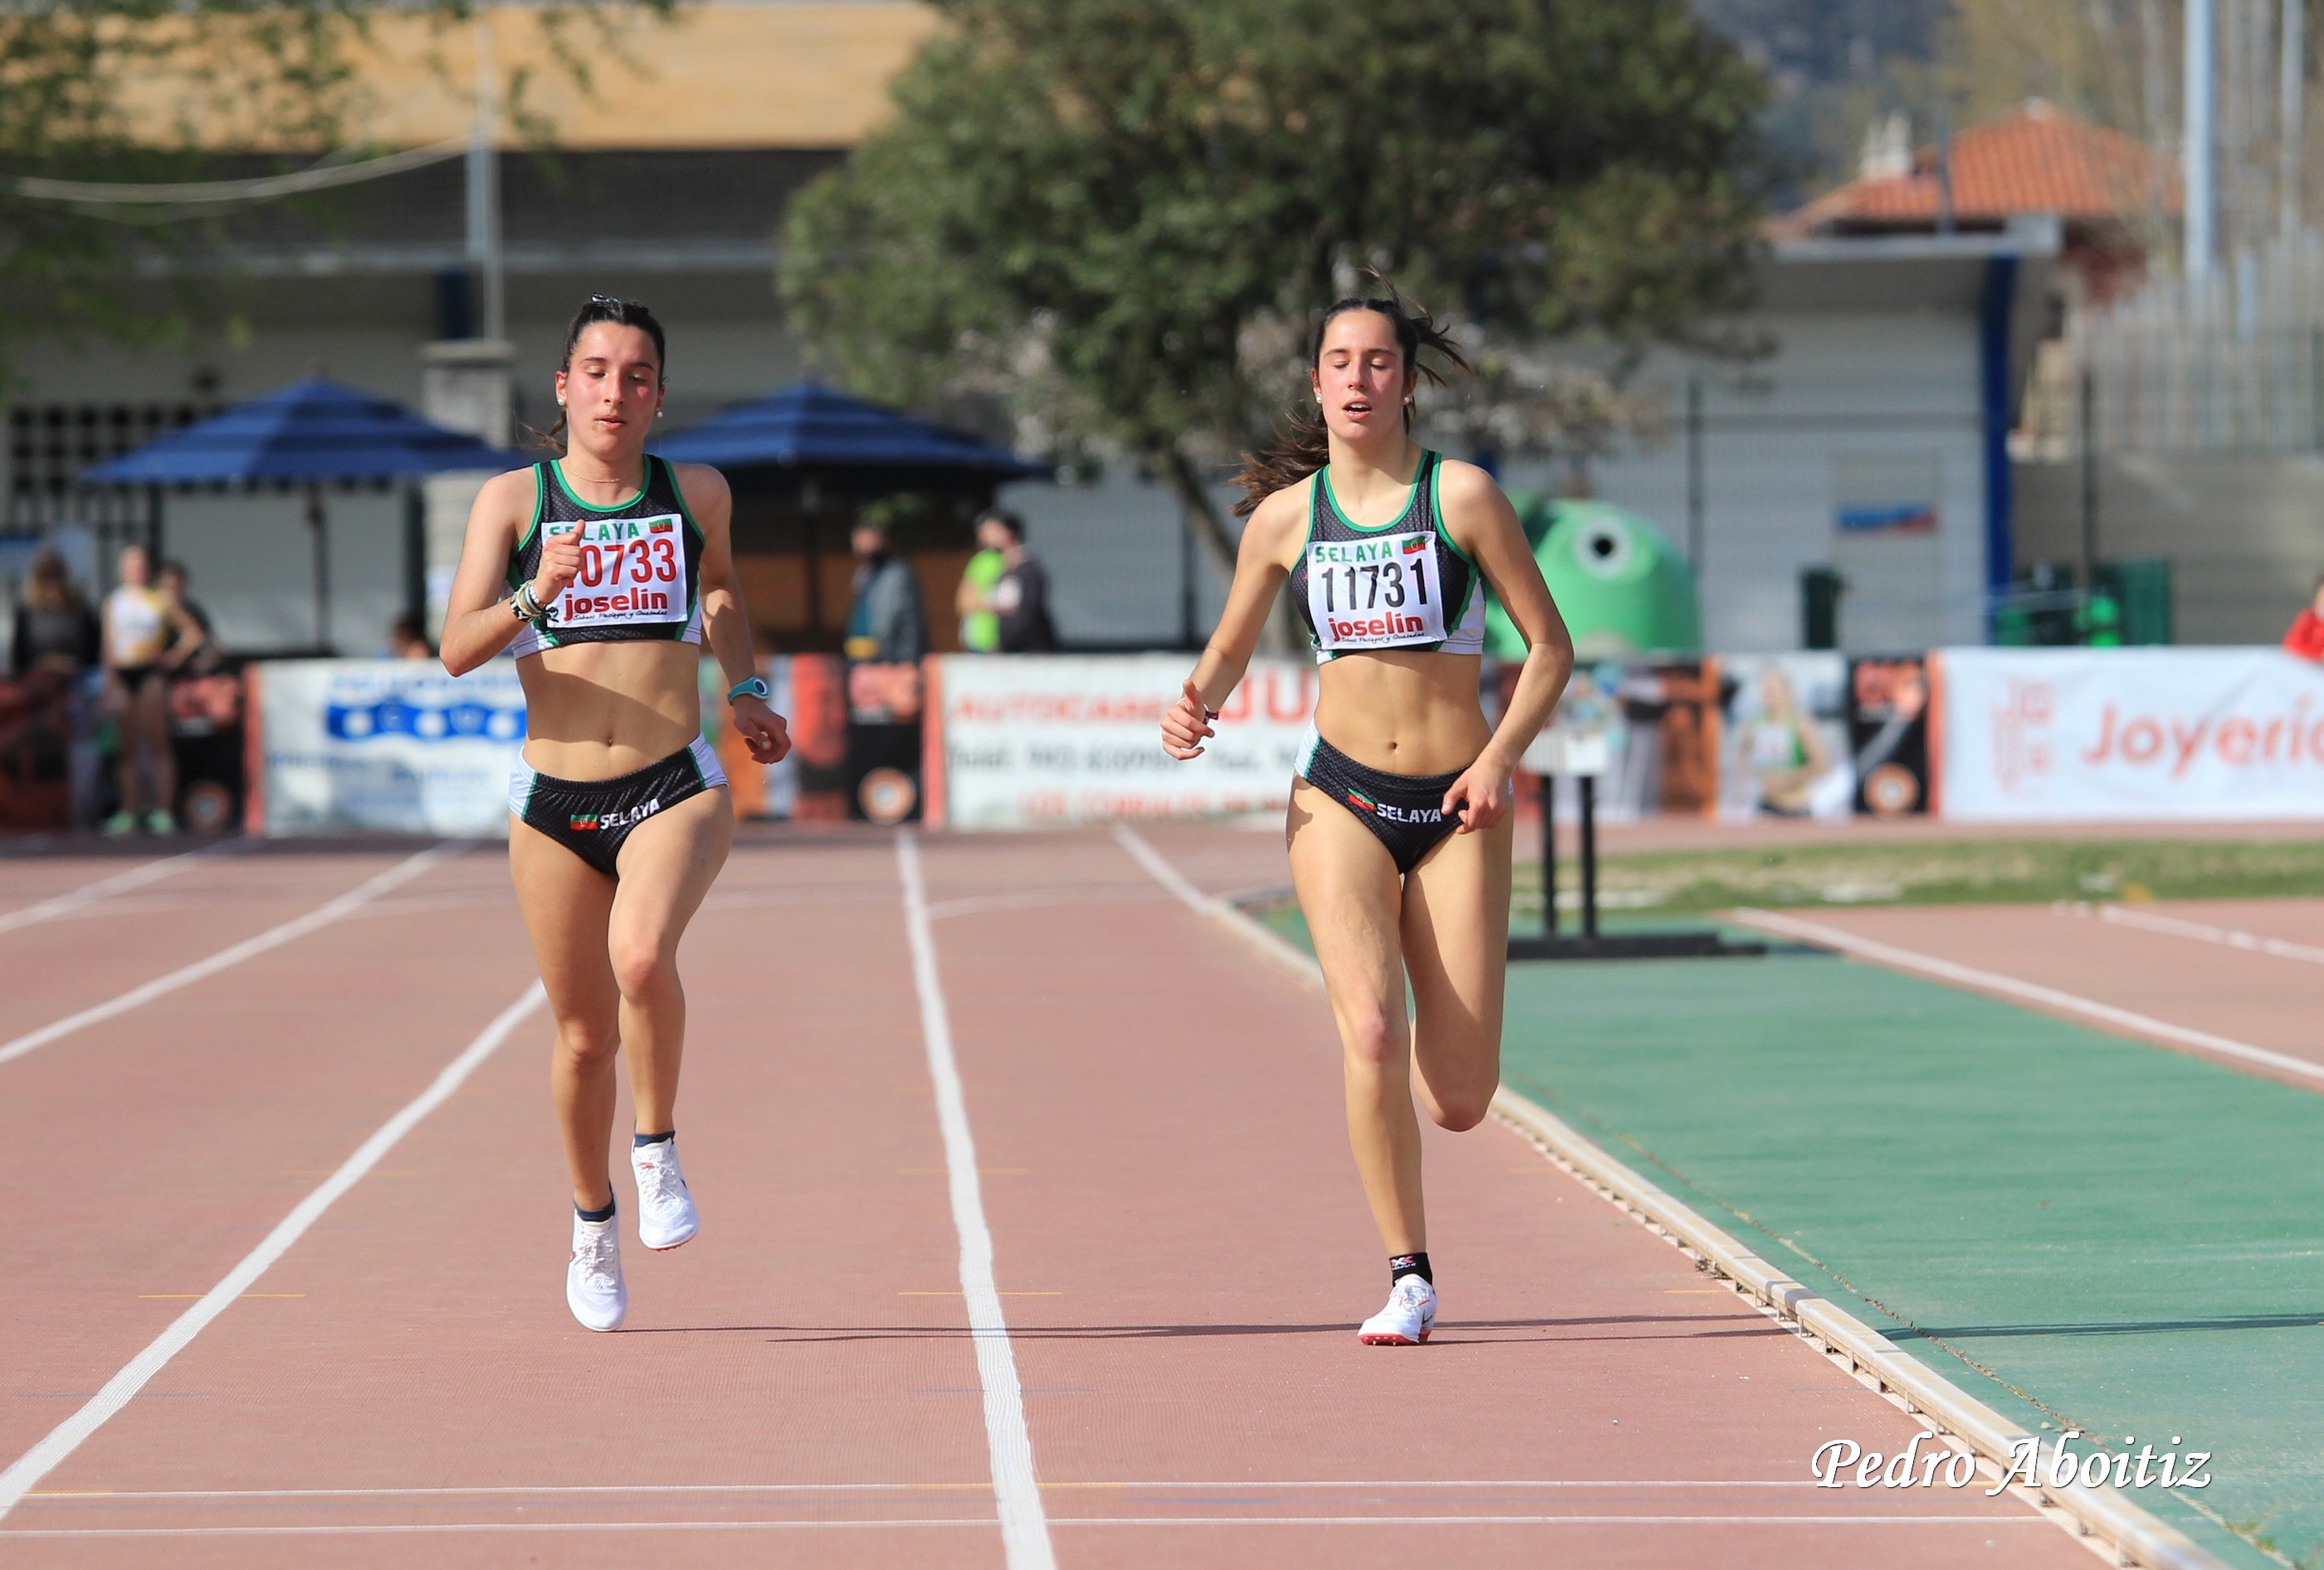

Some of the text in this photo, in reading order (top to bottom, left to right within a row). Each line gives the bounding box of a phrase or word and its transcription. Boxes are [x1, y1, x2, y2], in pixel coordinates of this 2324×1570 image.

[566, 539, 677, 588] 0733
[1315, 540, 1393, 563] SELAYA
[1321, 558, 1428, 612] 11731
[600, 797, 660, 829] SELAYA
[1376, 803, 1442, 823] SELAYA
